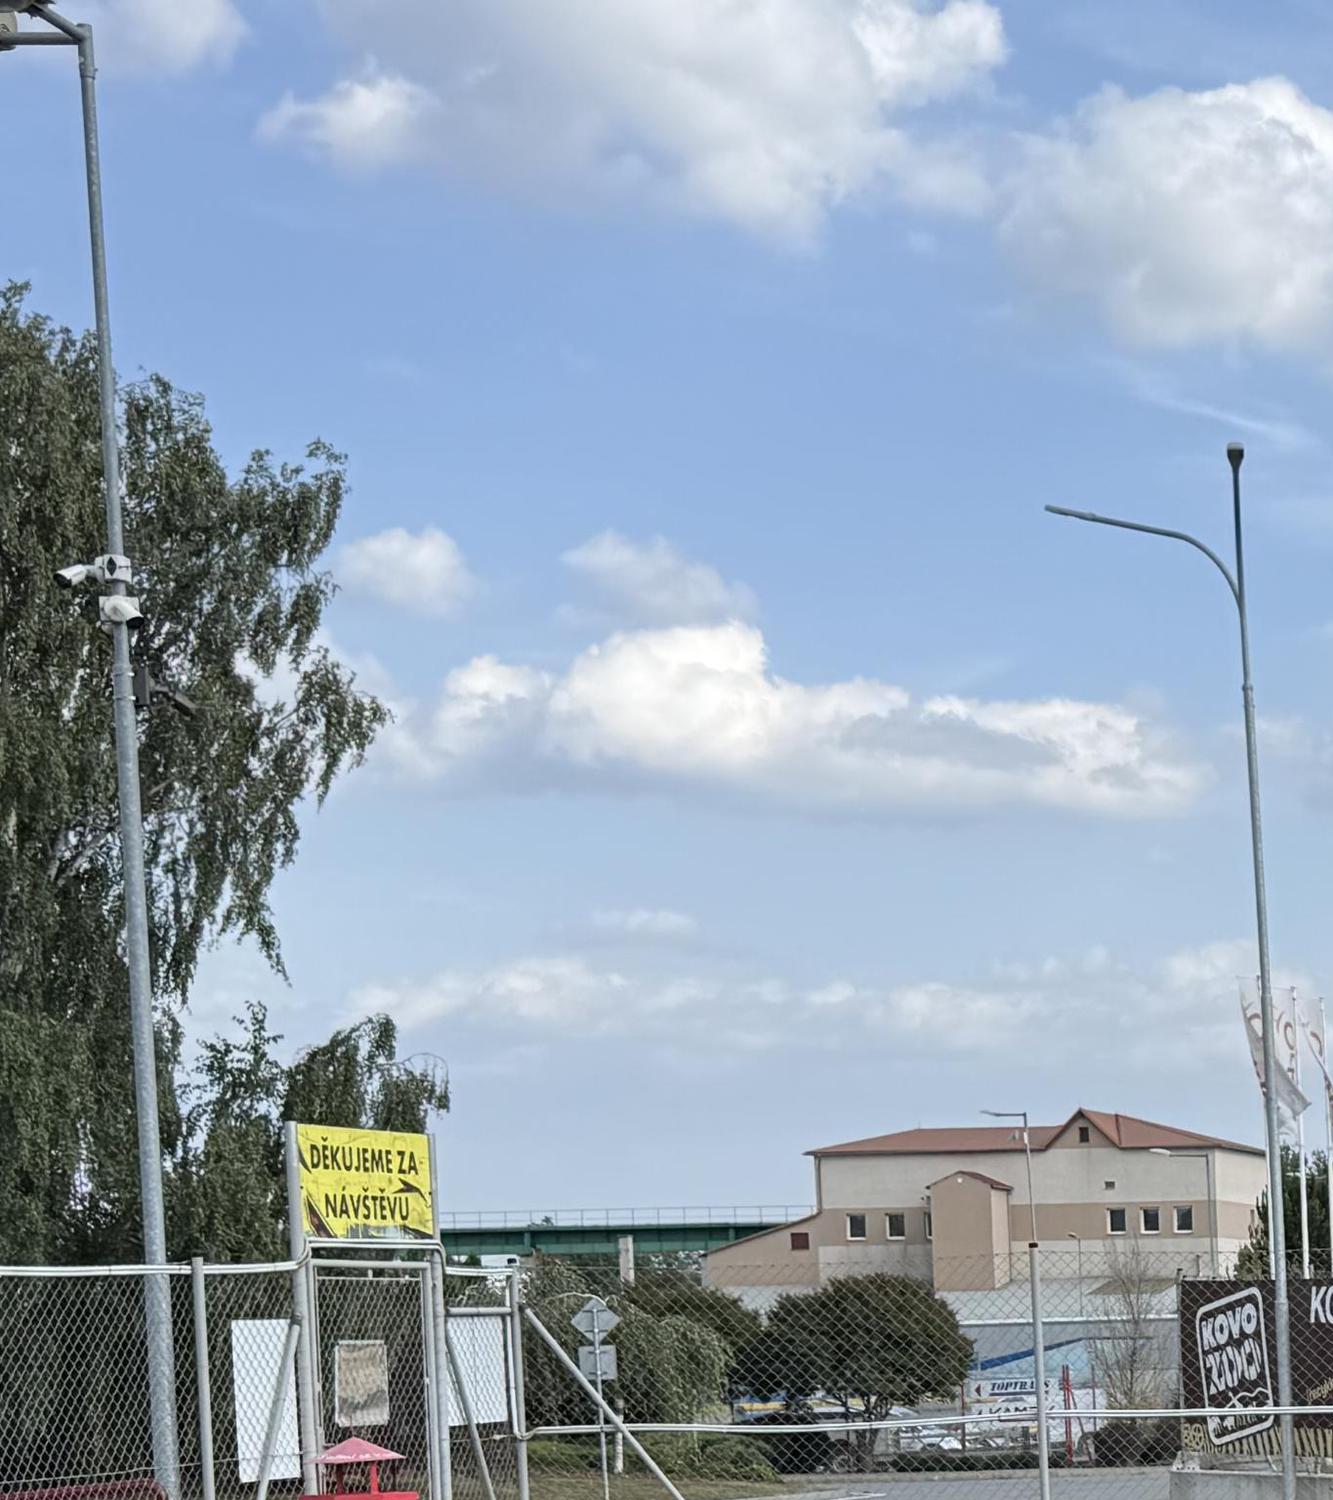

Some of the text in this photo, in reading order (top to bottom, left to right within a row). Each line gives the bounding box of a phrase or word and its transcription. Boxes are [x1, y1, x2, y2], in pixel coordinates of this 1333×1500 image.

[310, 1136, 419, 1175] DĚKUJEME ZA
[325, 1186, 410, 1221] NÁVŠTĚVU
[1201, 1303, 1258, 1350] KOVO
